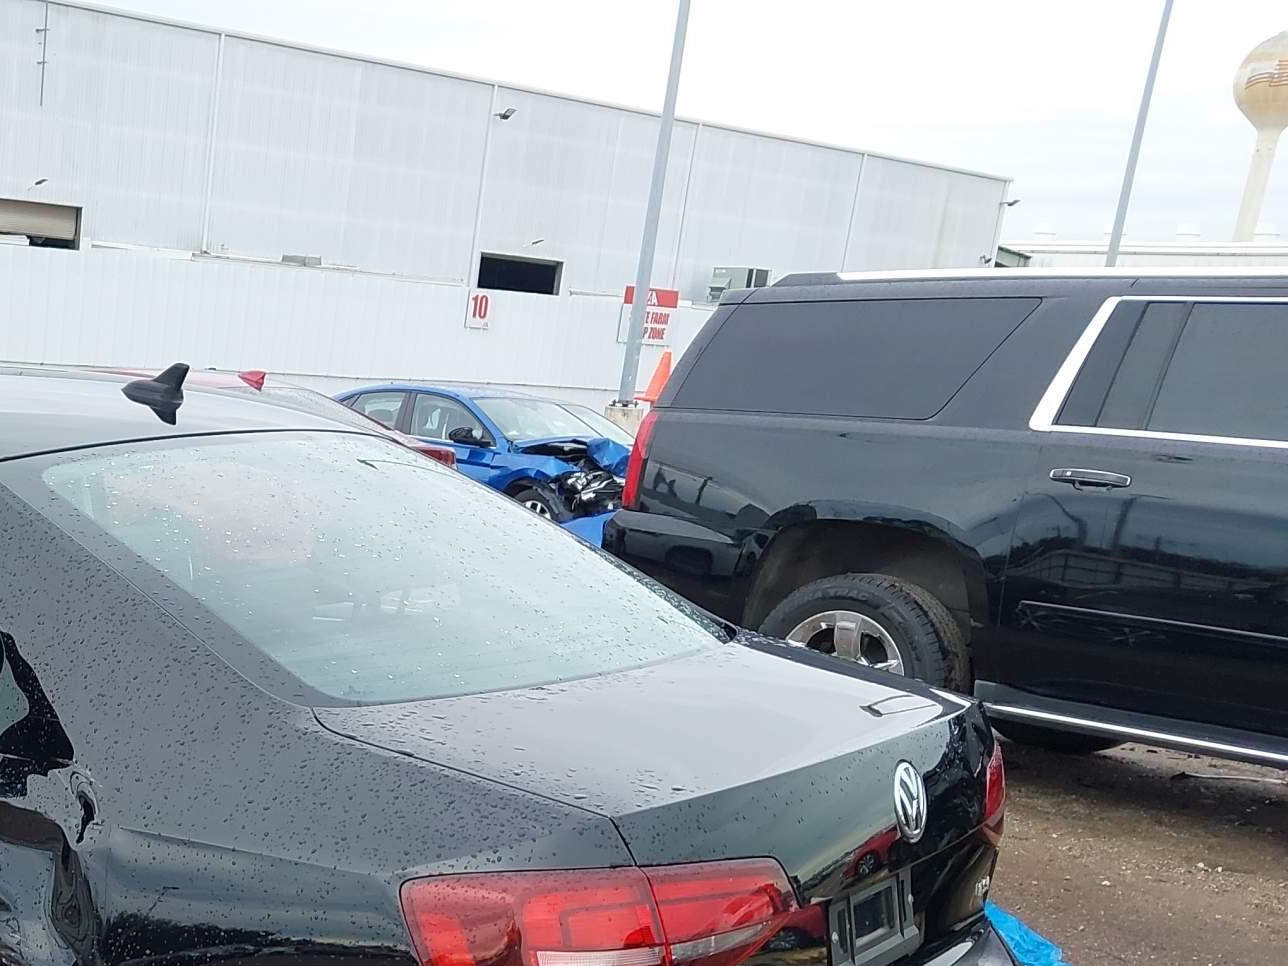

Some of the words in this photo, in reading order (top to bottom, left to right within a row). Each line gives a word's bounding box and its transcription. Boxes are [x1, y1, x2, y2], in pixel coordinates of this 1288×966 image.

[472, 294, 489, 320] 10
[650, 311, 670, 325] FARM
[648, 326, 666, 340] ZONE
